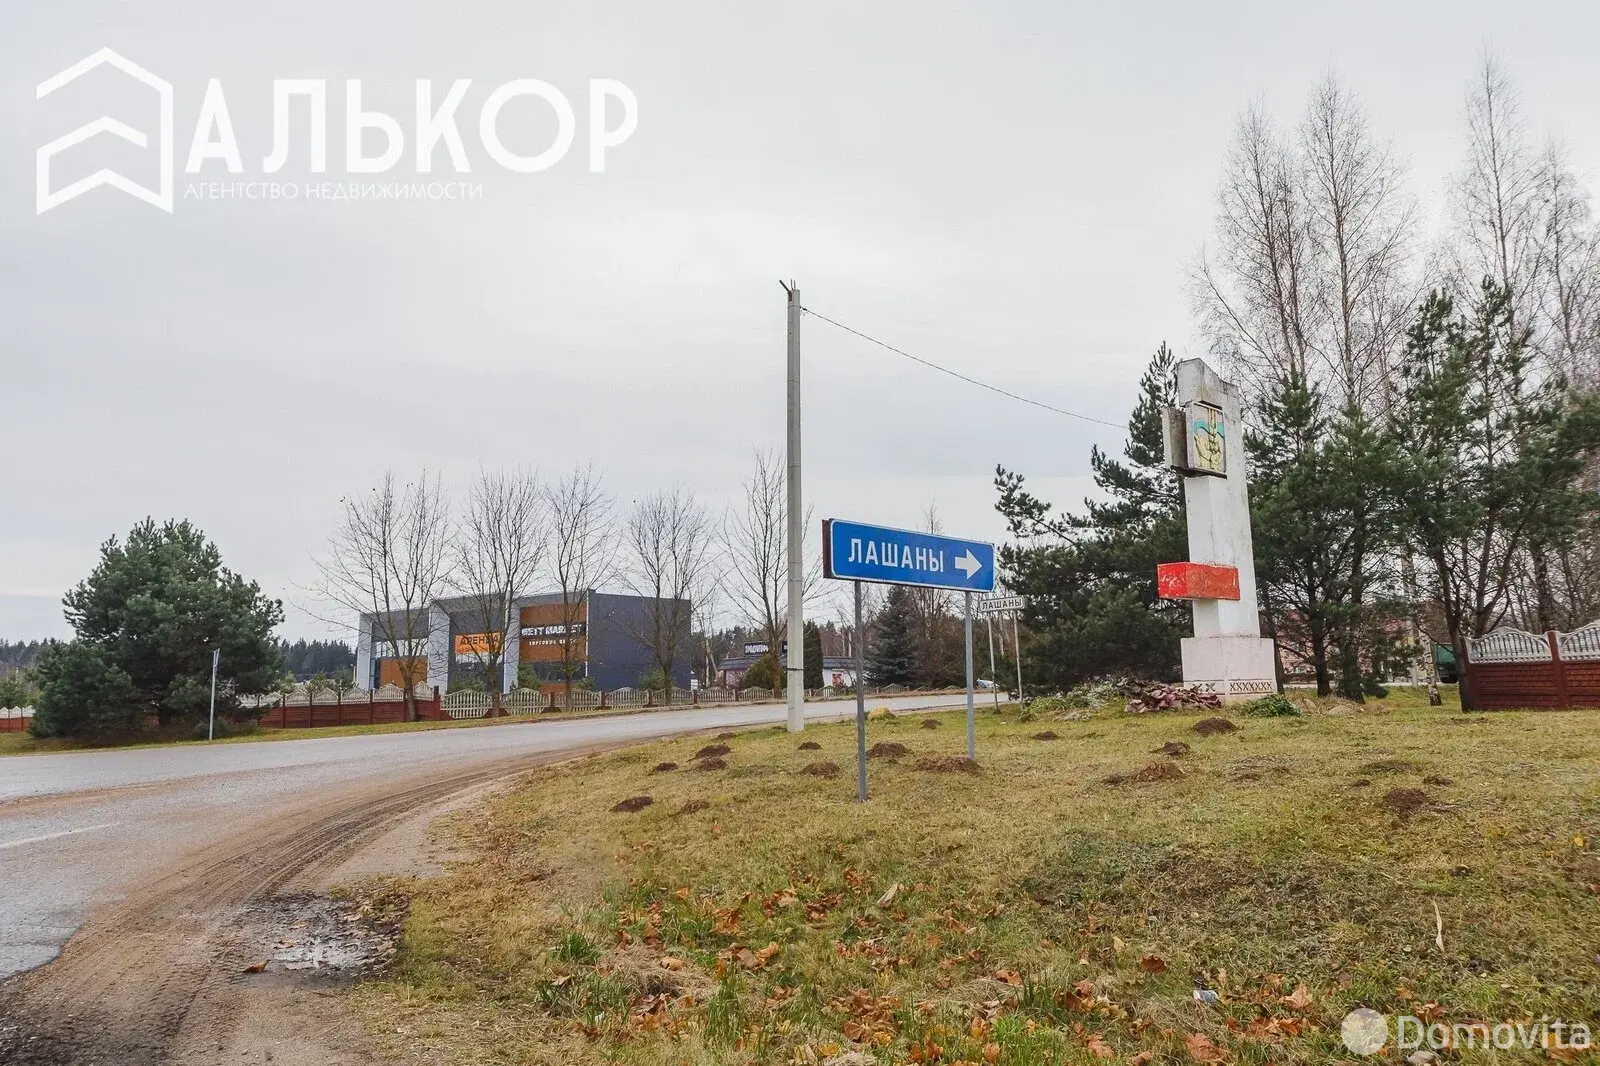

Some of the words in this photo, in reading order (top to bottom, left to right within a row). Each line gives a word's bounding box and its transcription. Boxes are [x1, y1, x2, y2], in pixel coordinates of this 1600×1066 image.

[848, 538, 944, 573] ЛАШАНЫ
[982, 598, 1022, 610] ЛАШАНЫ
[545, 624, 582, 635] MARET
[460, 634, 500, 646] АРЕНА
